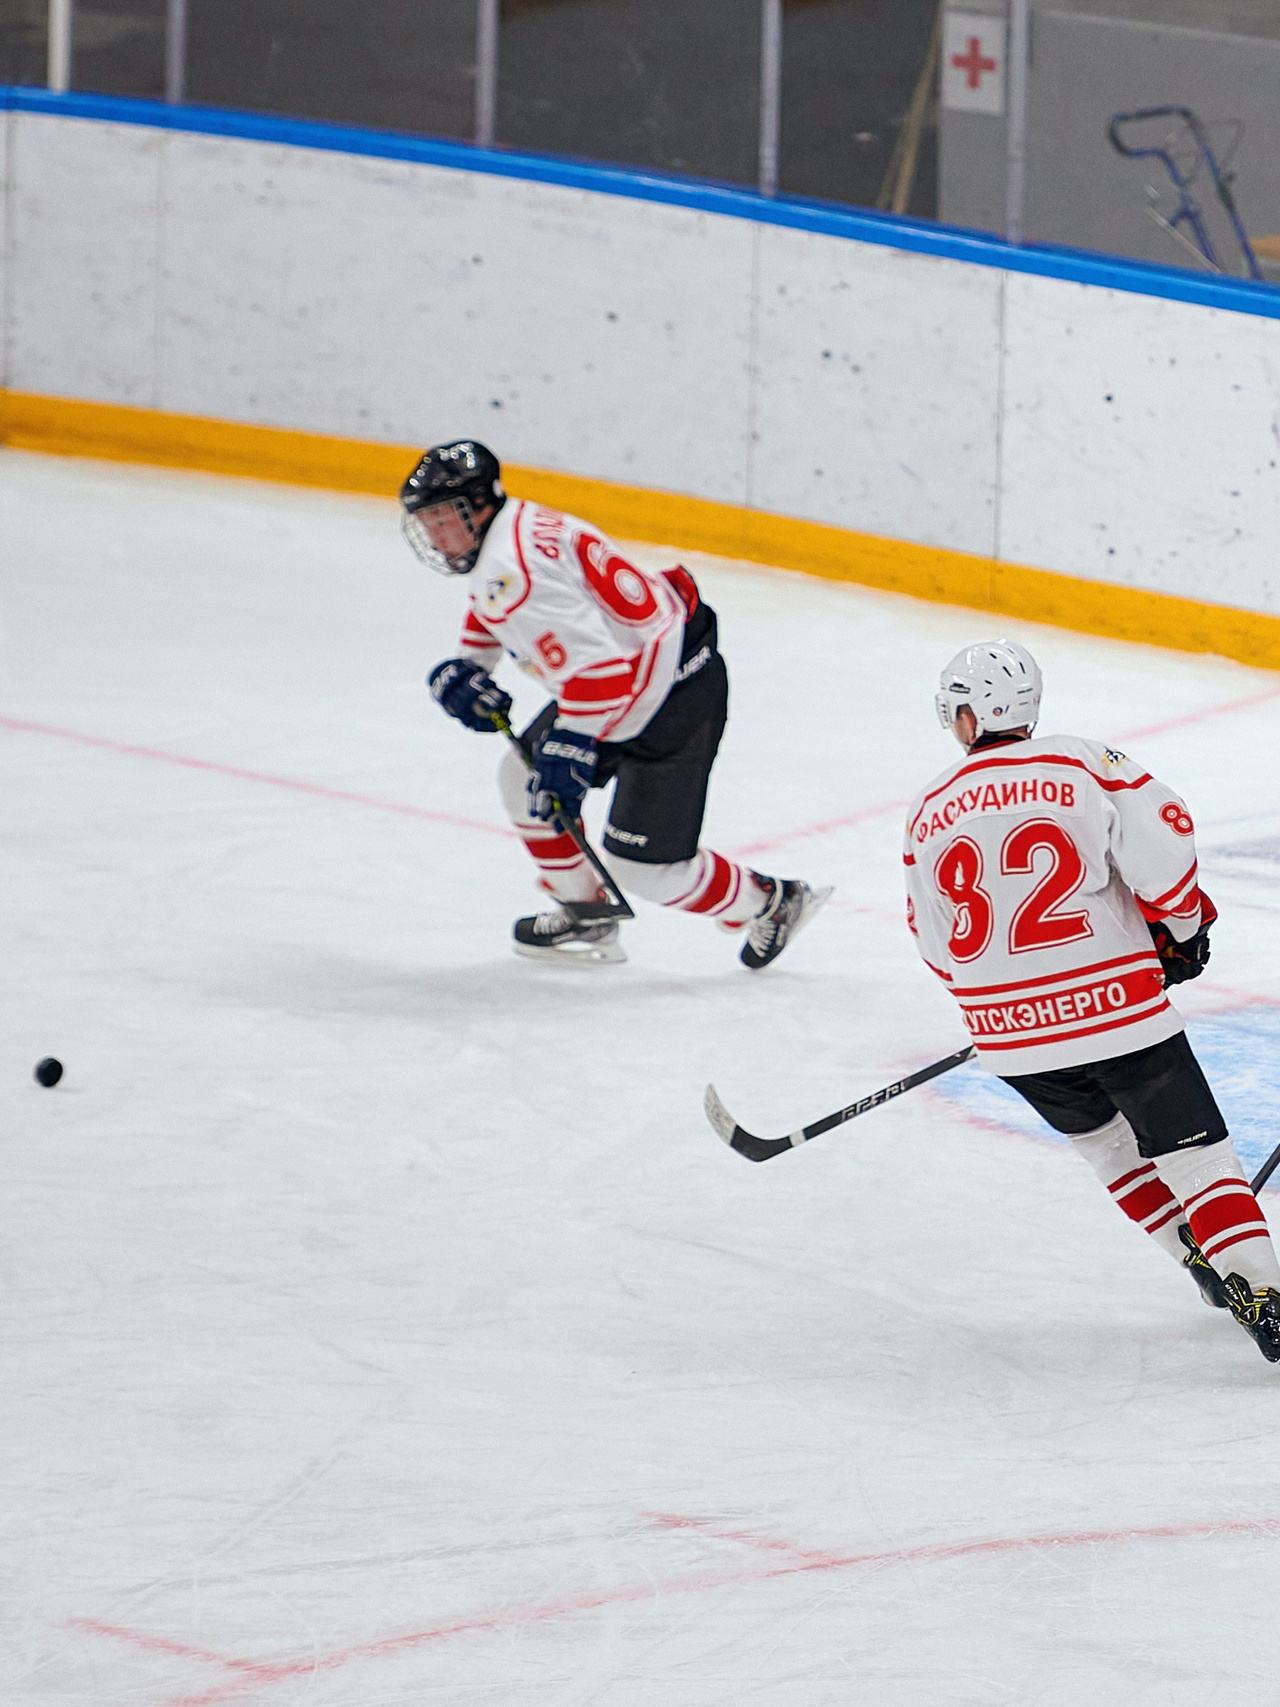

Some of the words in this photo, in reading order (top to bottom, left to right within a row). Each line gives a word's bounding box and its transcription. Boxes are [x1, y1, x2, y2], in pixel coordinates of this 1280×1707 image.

[571, 528, 661, 627] 6
[1158, 801, 1195, 837] 8
[934, 817, 1094, 964] 82
[965, 981, 1128, 1033] УТСКЭНЕРГО
